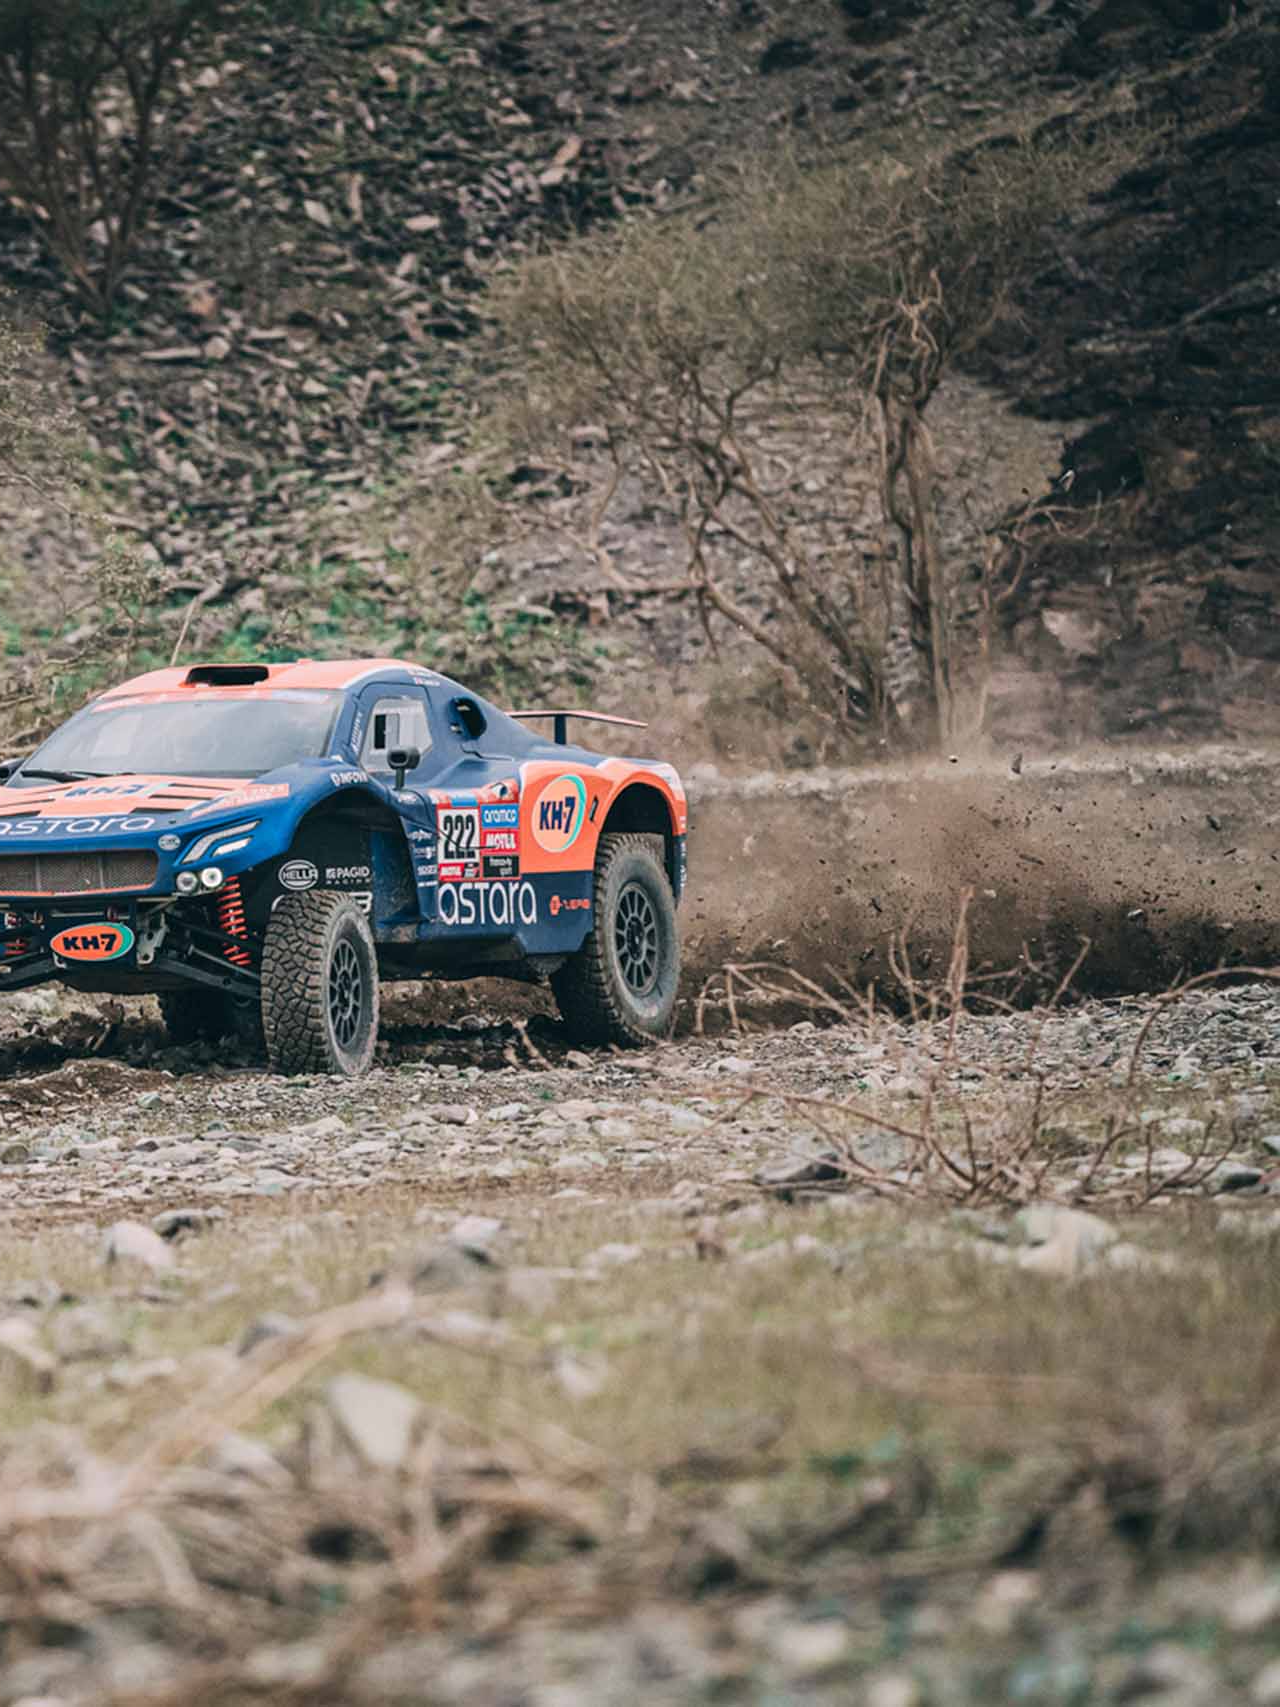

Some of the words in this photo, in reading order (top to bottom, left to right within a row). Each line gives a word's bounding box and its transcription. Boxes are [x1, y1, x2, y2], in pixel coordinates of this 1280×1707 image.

[484, 809, 516, 823] aramco
[443, 814, 476, 859] 222
[486, 832, 516, 849] MOTUL
[282, 867, 319, 881] HELLA
[336, 866, 370, 879] PAGID
[438, 881, 538, 925] astara
